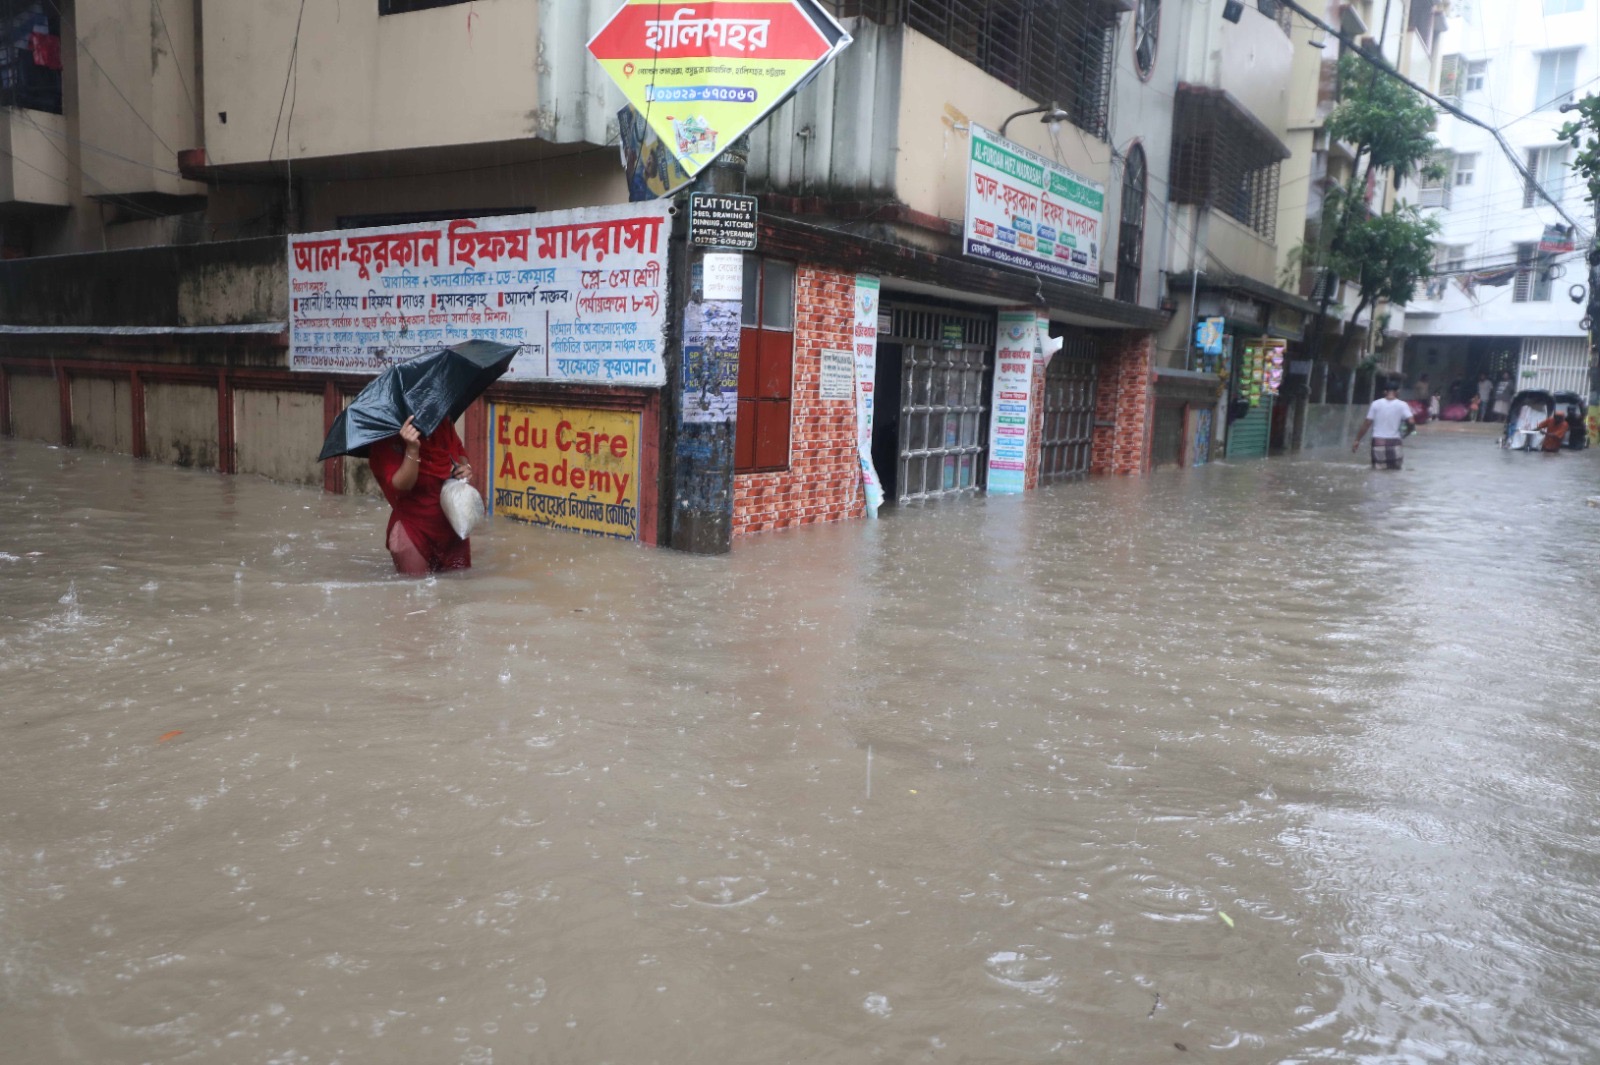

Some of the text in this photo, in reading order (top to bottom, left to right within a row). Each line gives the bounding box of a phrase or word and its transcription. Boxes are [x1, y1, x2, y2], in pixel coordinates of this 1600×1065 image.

[645, 8, 770, 51] হালিশহর
[657, 88, 755, 101] ০১৩২৯-৬৭৫০৬৭
[694, 197, 718, 209] FLAT
[974, 172, 1038, 220] আল-ফুরকান
[1066, 209, 1098, 241] মাদরাসা
[712, 212, 743, 220] DRAWING
[725, 221, 754, 229] KITCHEN
[293, 216, 664, 280] আল-ফুরকান হিফয মাদরাসা
[380, 269, 419, 288] আবাসিক
[429, 267, 486, 286] অনাবাসিক
[634, 260, 660, 287] শ্রেণী
[368, 289, 394, 310] হিফয
[504, 285, 540, 306] আদর্শ
[451, 307, 481, 325] সমাপ্তির
[484, 306, 511, 323] মিশন।
[550, 319, 573, 336] বর্তমান
[593, 322, 637, 335] বাংলাদেশকে
[583, 340, 612, 354] অন্যতম
[637, 339, 656, 354] হচ্ছে
[556, 358, 656, 379] হাফেজে কুরআন।
[498, 415, 628, 458] Edu Care
[499, 451, 630, 505] Academy
[495, 487, 524, 510] সকল
[526, 486, 567, 518] বিষয়ের
[605, 498, 636, 531] কোচিং
